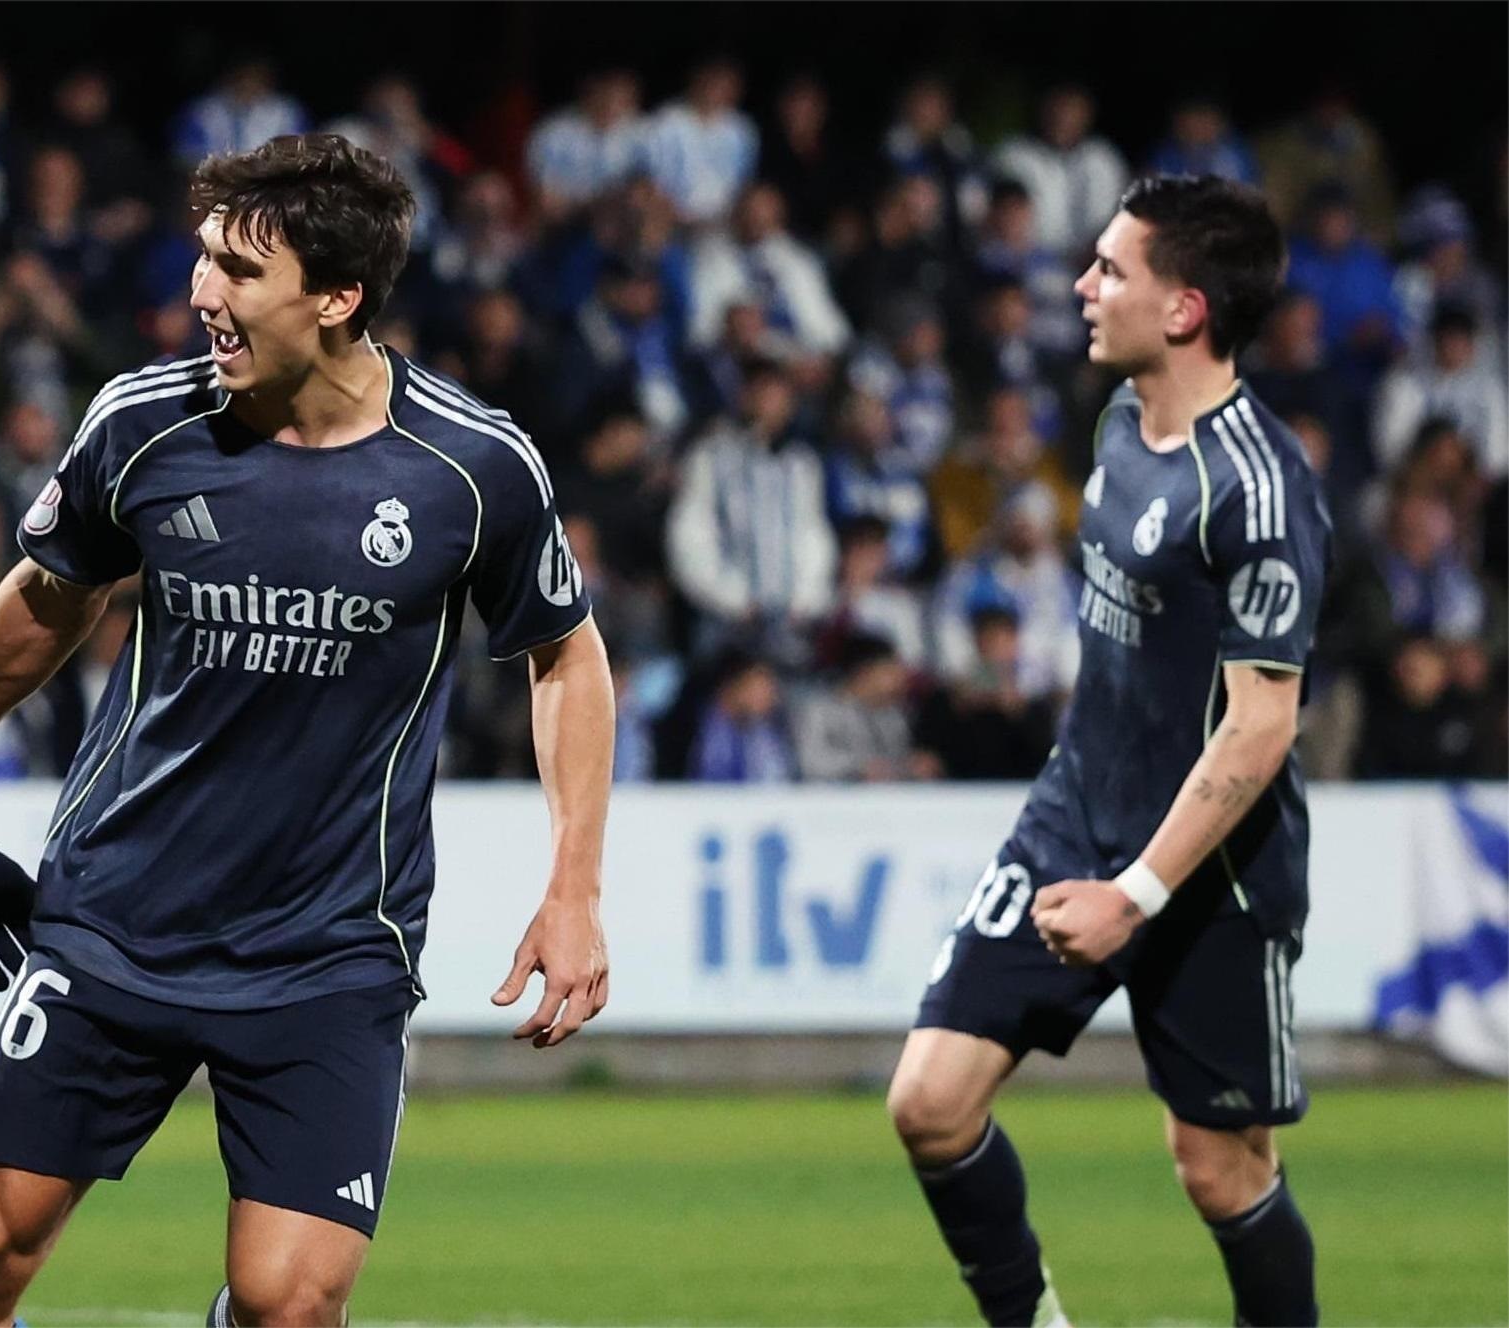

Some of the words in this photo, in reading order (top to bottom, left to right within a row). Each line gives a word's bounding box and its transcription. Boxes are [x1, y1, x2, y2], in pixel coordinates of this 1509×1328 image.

[158, 569, 395, 634] Emirates
[1081, 540, 1164, 615] mirates
[1237, 557, 1296, 640] hp
[192, 628, 238, 670] FLY
[244, 632, 353, 677] BETTER
